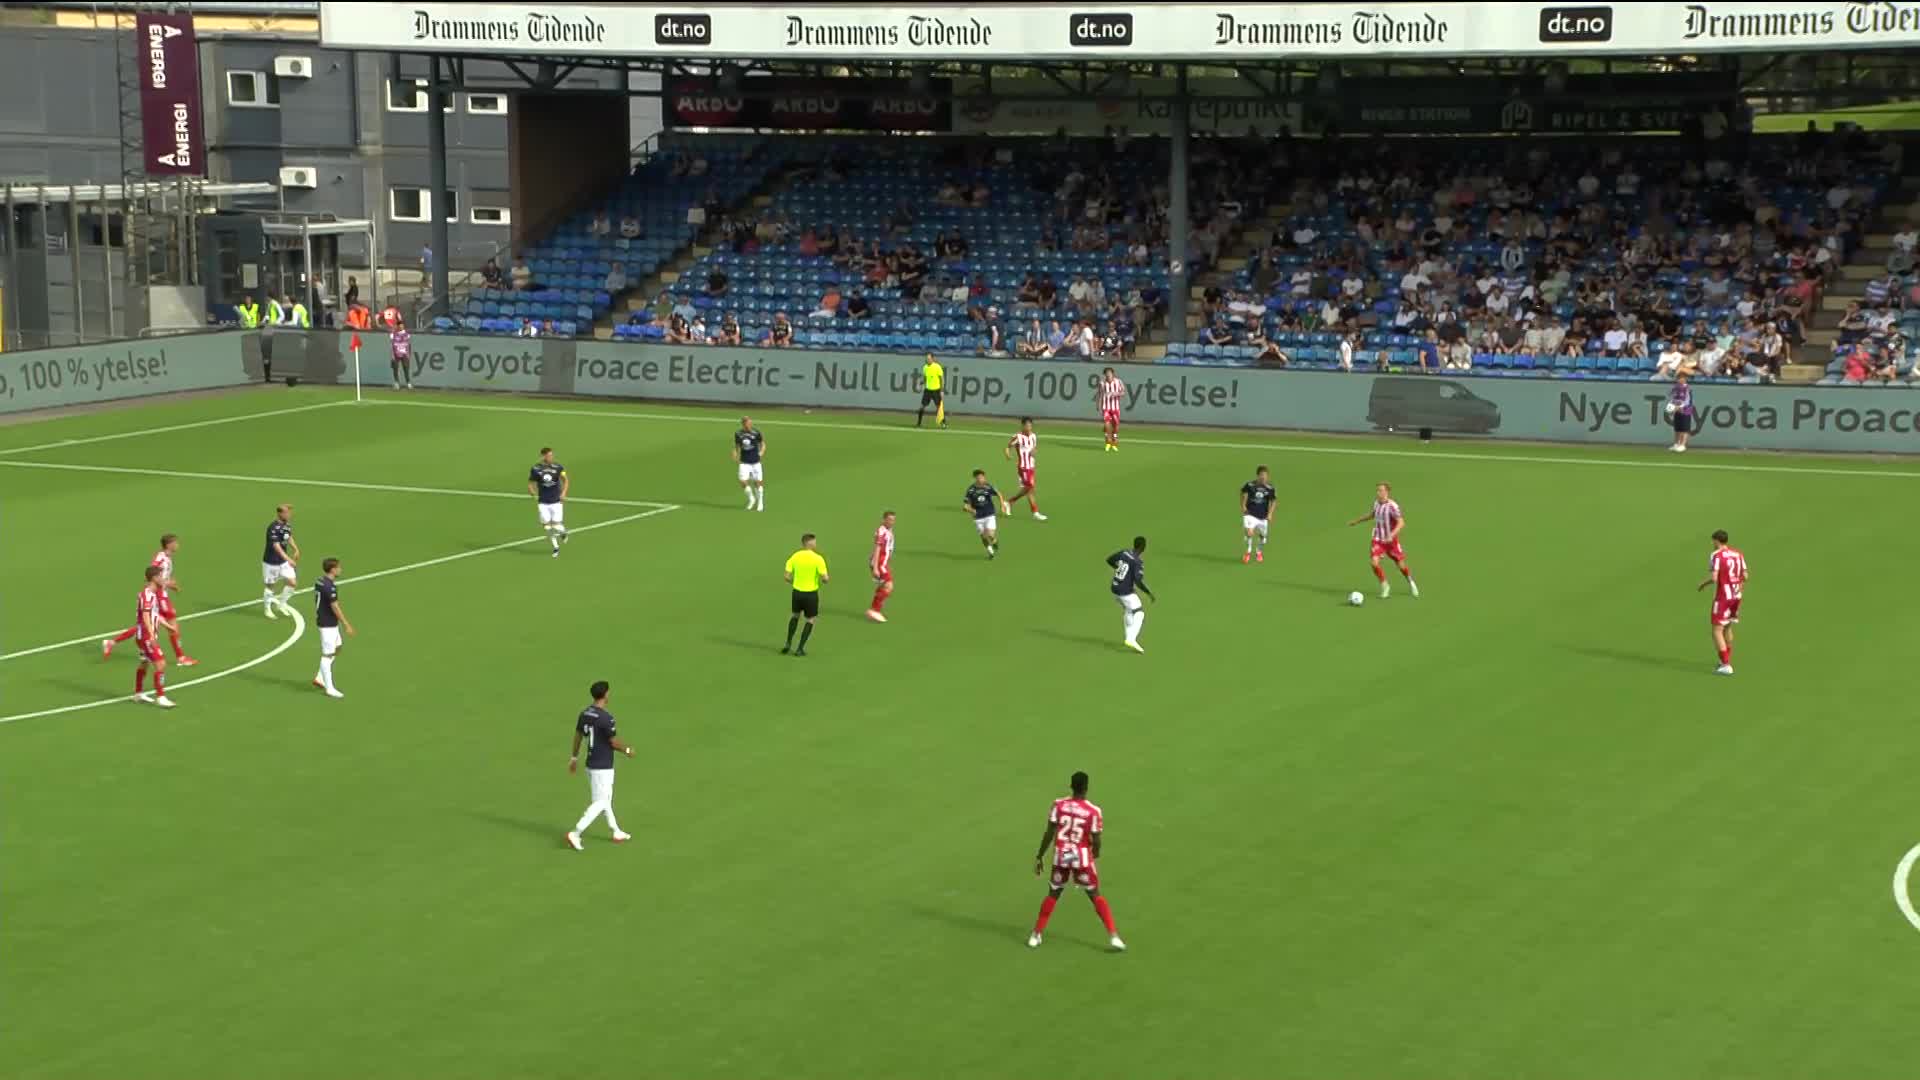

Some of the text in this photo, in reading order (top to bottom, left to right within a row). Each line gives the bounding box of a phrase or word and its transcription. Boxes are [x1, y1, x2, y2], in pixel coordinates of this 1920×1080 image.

[414, 10, 605, 42] Drammens Tidende
[661, 18, 706, 38] dt.no
[786, 15, 992, 46] Drammens Tidende
[1076, 17, 1127, 38] dt.no
[1215, 11, 1448, 45] Drammens Tidende
[1547, 12, 1606, 34] dt.no
[1684, 5, 1833, 39] Drammens
[149, 24, 166, 89] ENERGI
[173, 103, 191, 167] ENERGI
[20, 359, 62, 392] 100
[67, 356, 89, 385] %
[93, 348, 169, 391] ytelse!
[668, 355, 780, 388] Electric
[814, 361, 880, 392] Null
[890, 365, 1012, 404] utlipp,
[1023, 371, 1078, 401] 100
[1125, 375, 1239, 412] ytelse!
[1559, 391, 1633, 432] Nye
[1057, 814, 1087, 844] 25
